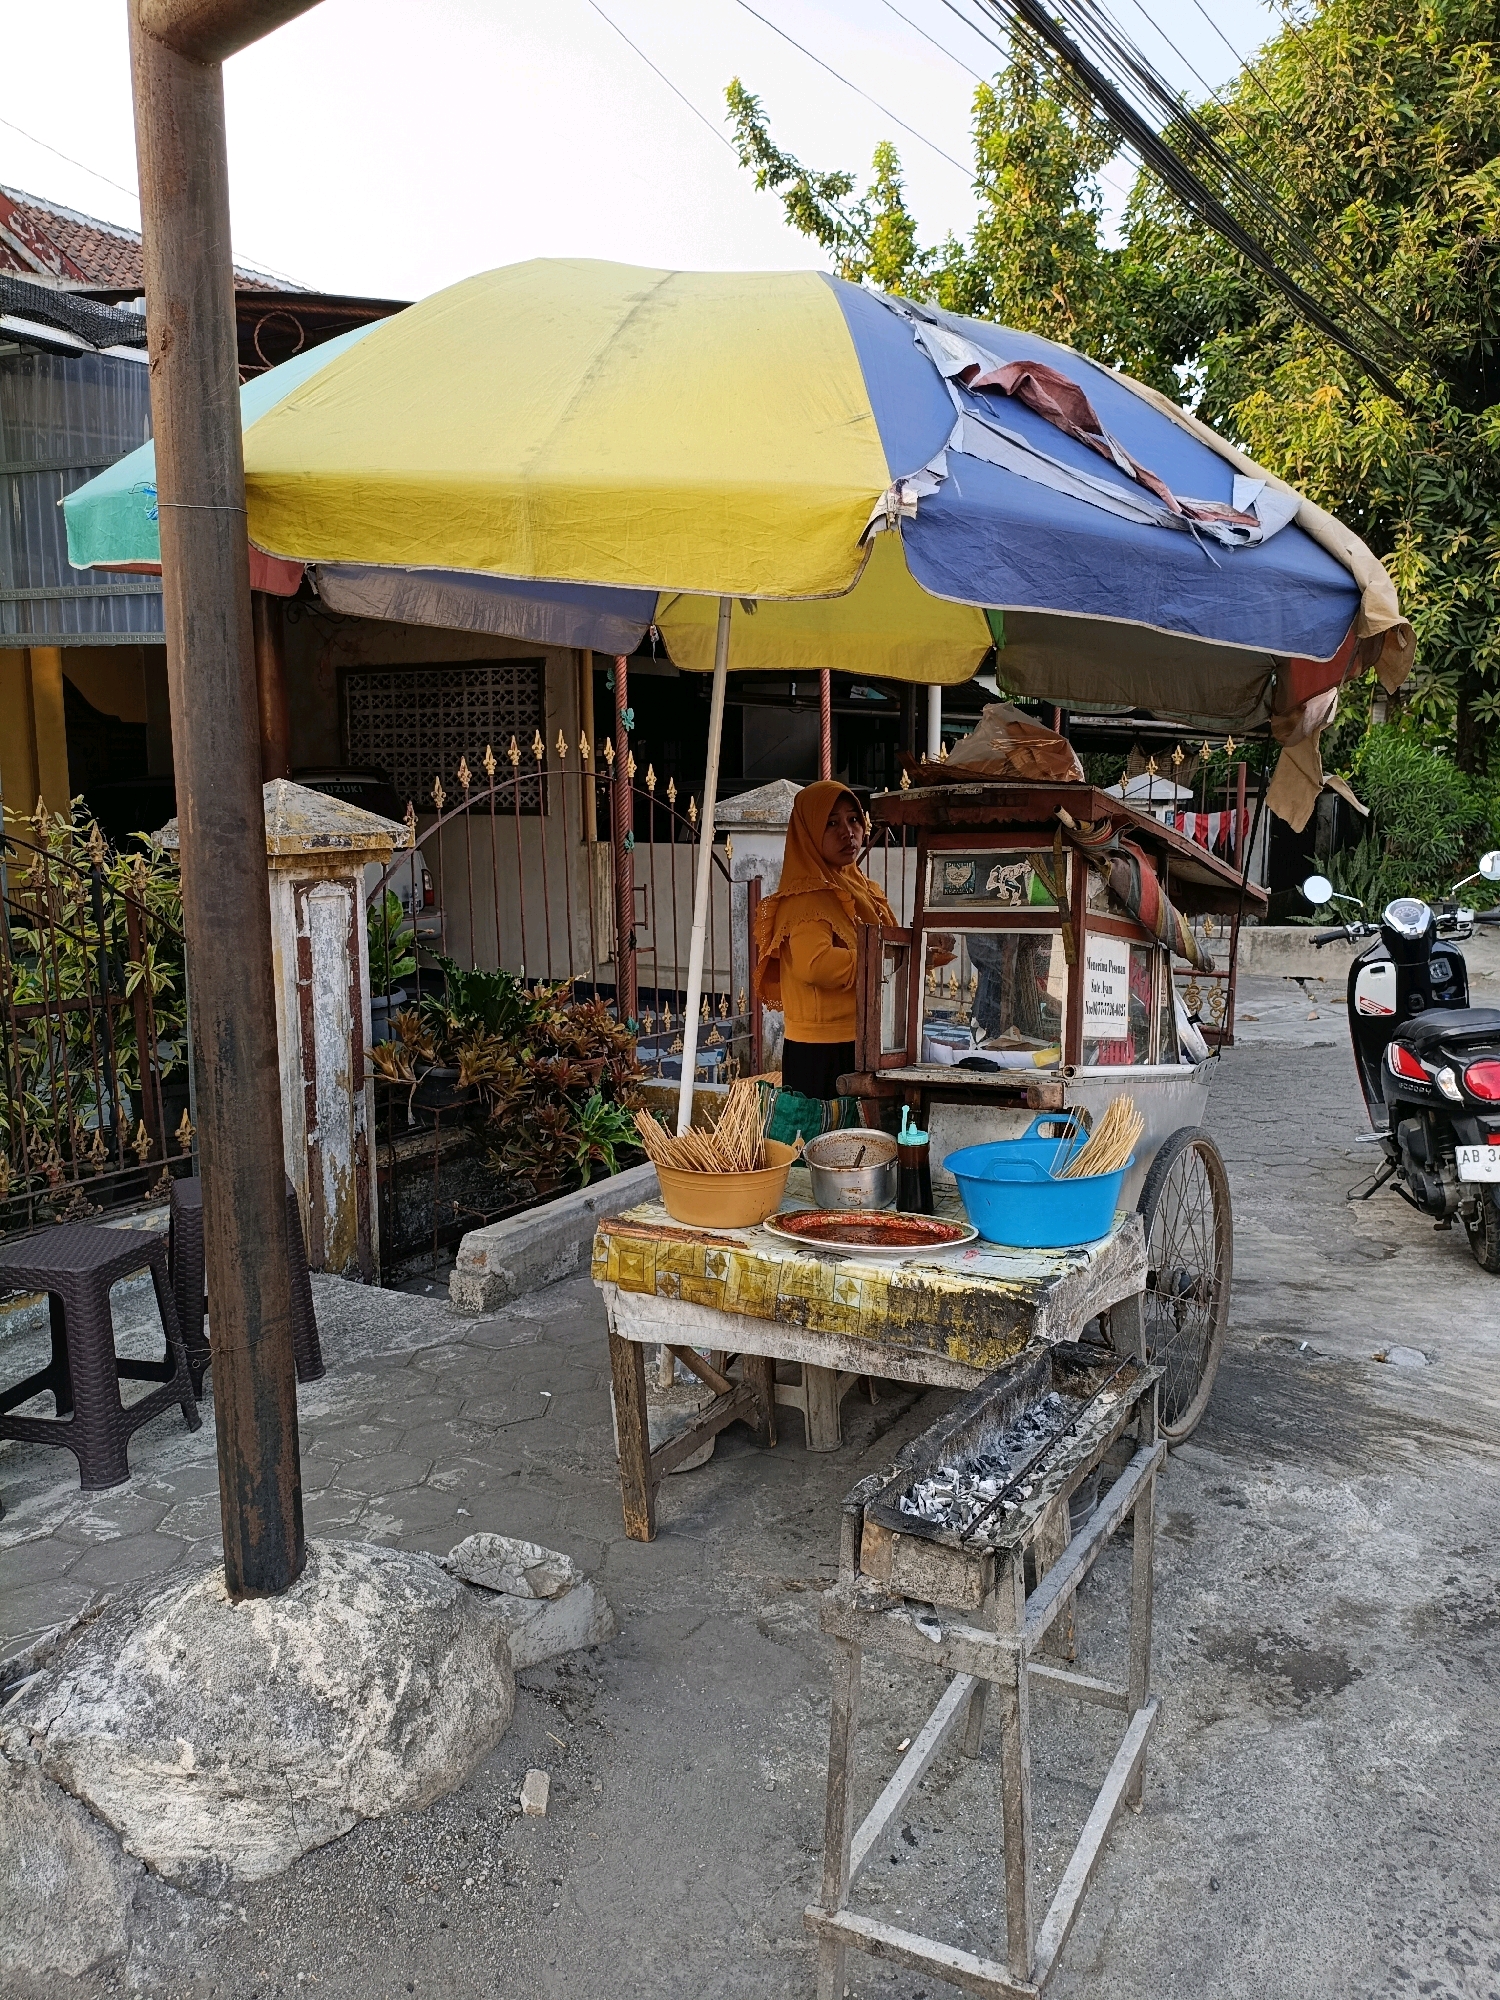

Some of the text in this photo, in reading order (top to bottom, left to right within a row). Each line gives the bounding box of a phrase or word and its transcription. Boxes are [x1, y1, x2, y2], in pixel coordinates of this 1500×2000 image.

[316, 785, 363, 794] SUZUKI
[1091, 978, 1113, 998] Sate Ayam
[1462, 1148, 1500, 1163] AB 3
